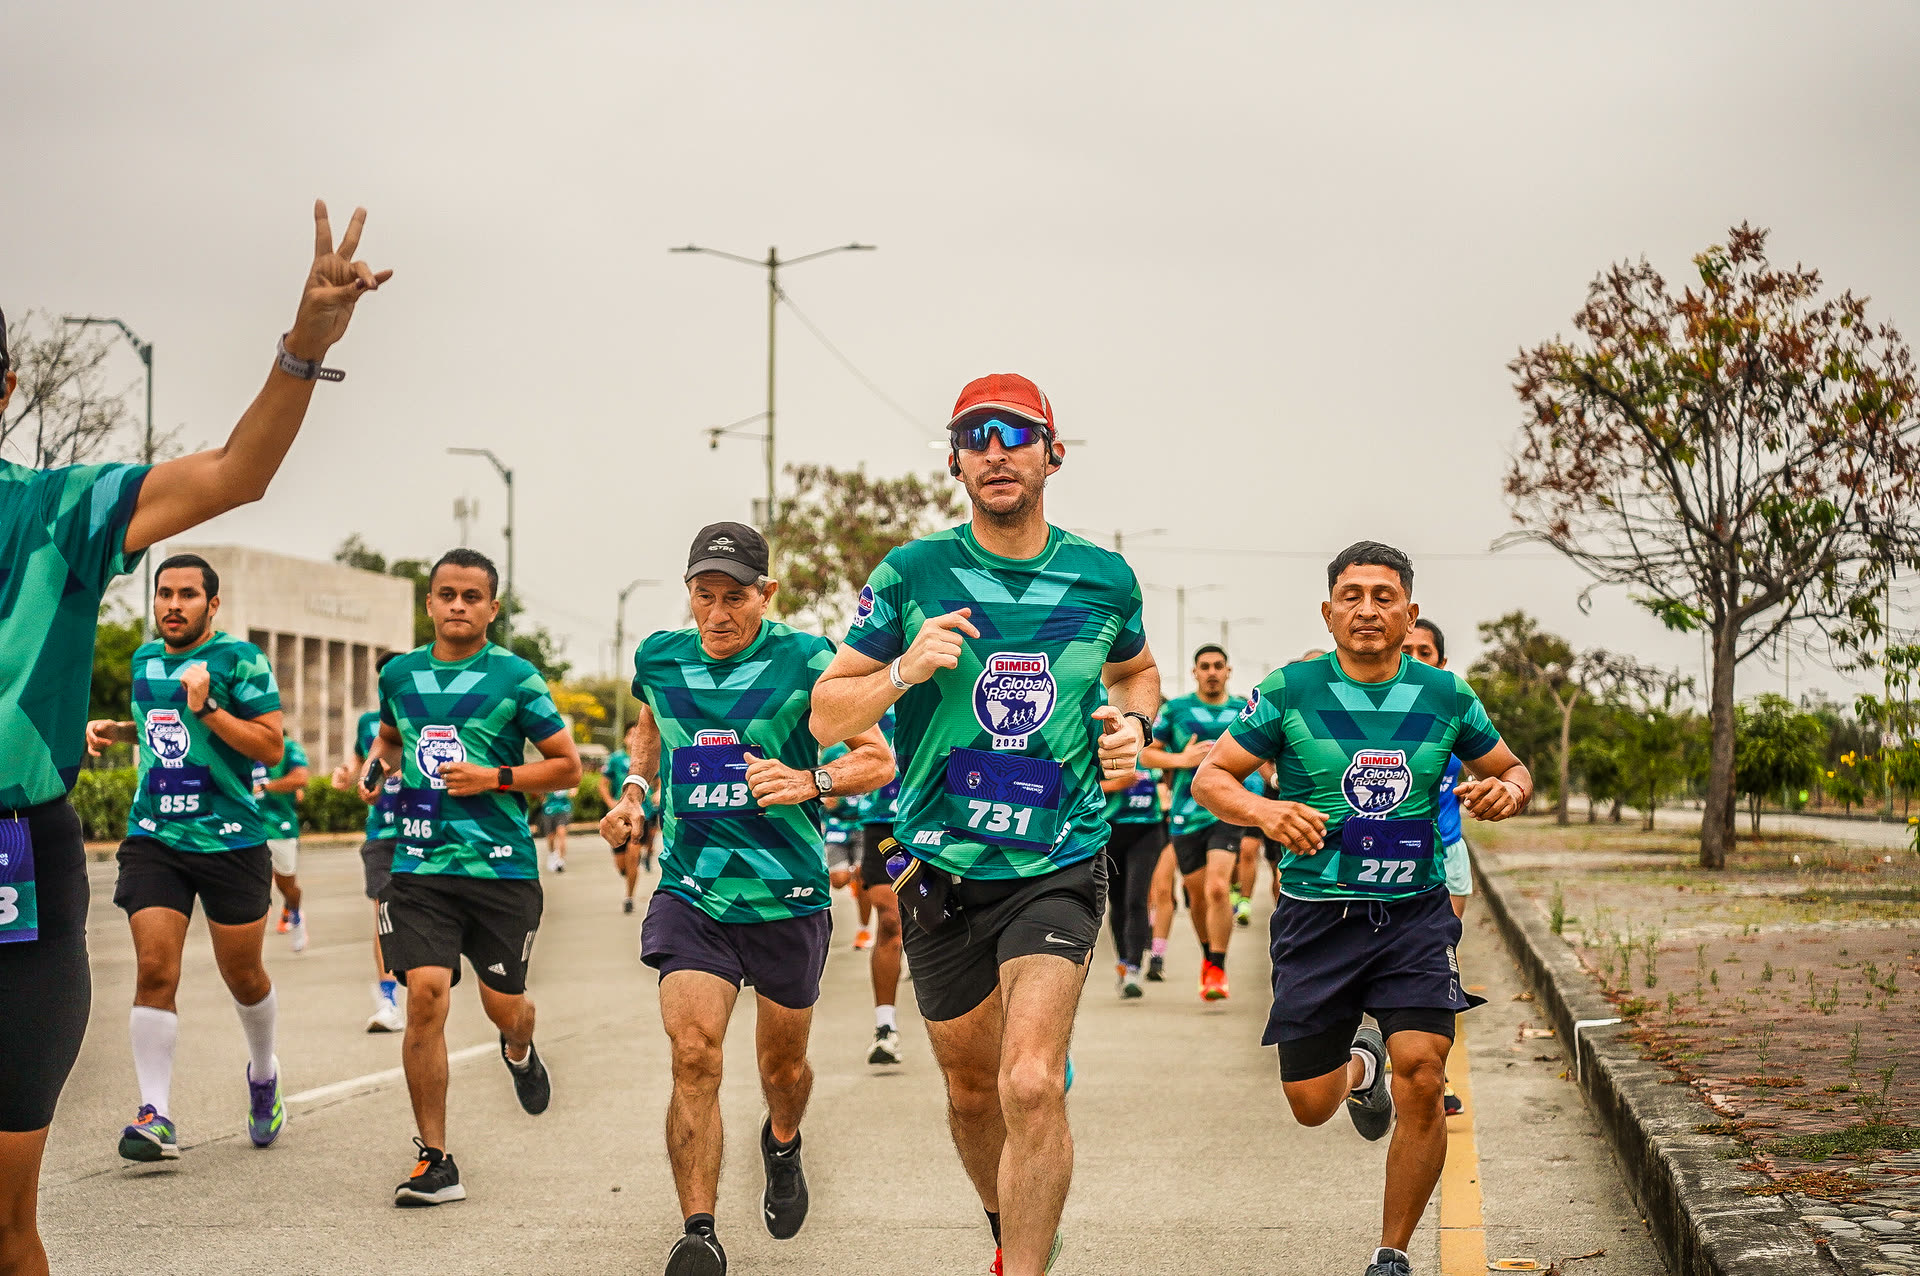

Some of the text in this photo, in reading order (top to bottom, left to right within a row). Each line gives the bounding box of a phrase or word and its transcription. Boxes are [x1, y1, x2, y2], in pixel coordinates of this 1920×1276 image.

[995, 661, 1040, 672] BIMBO
[999, 677, 1047, 690] Global
[987, 688, 1026, 700] Race
[430, 741, 458, 750] Global
[701, 737, 734, 745] BIMBO
[995, 738, 1025, 748] 2025
[1360, 756, 1399, 765] BIMBO
[1363, 768, 1404, 779] Global
[1353, 777, 1386, 786] Race
[688, 783, 748, 808] 443
[159, 794, 200, 813] 855
[967, 800, 1032, 836] 731
[402, 818, 432, 839] 246
[1357, 859, 1416, 883] 272
